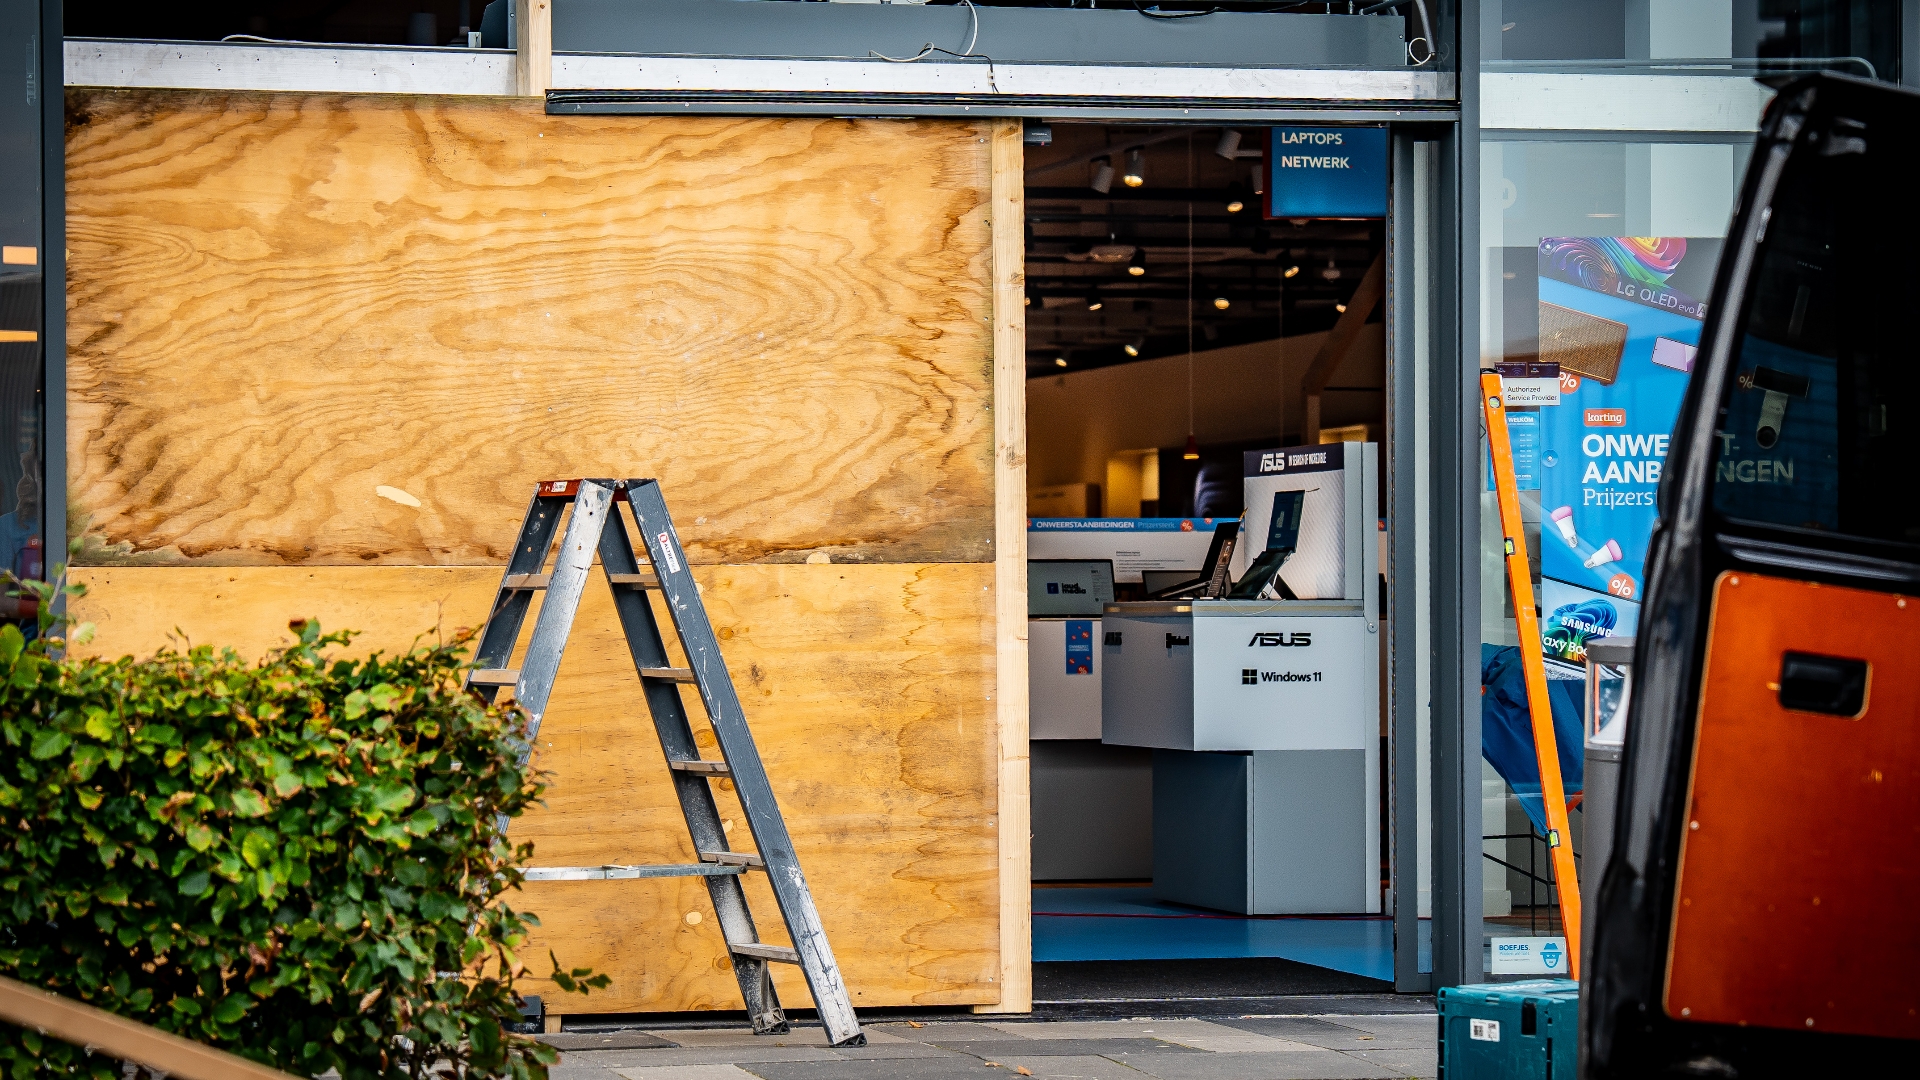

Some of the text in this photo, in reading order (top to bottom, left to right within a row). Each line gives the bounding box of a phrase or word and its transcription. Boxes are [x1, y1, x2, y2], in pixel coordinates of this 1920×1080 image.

[1616, 281, 1636, 297] LG
[1639, 288, 1678, 308] OLED
[1678, 304, 1695, 314] evo
[1587, 412, 1622, 424] korting
[1259, 452, 1285, 472] ASUS
[1583, 487, 1659, 510] Prijzers
[1561, 616, 1612, 637] SAMSUNG
[1248, 632, 1311, 647] ASUS
[1261, 670, 1322, 682] Windows 11
